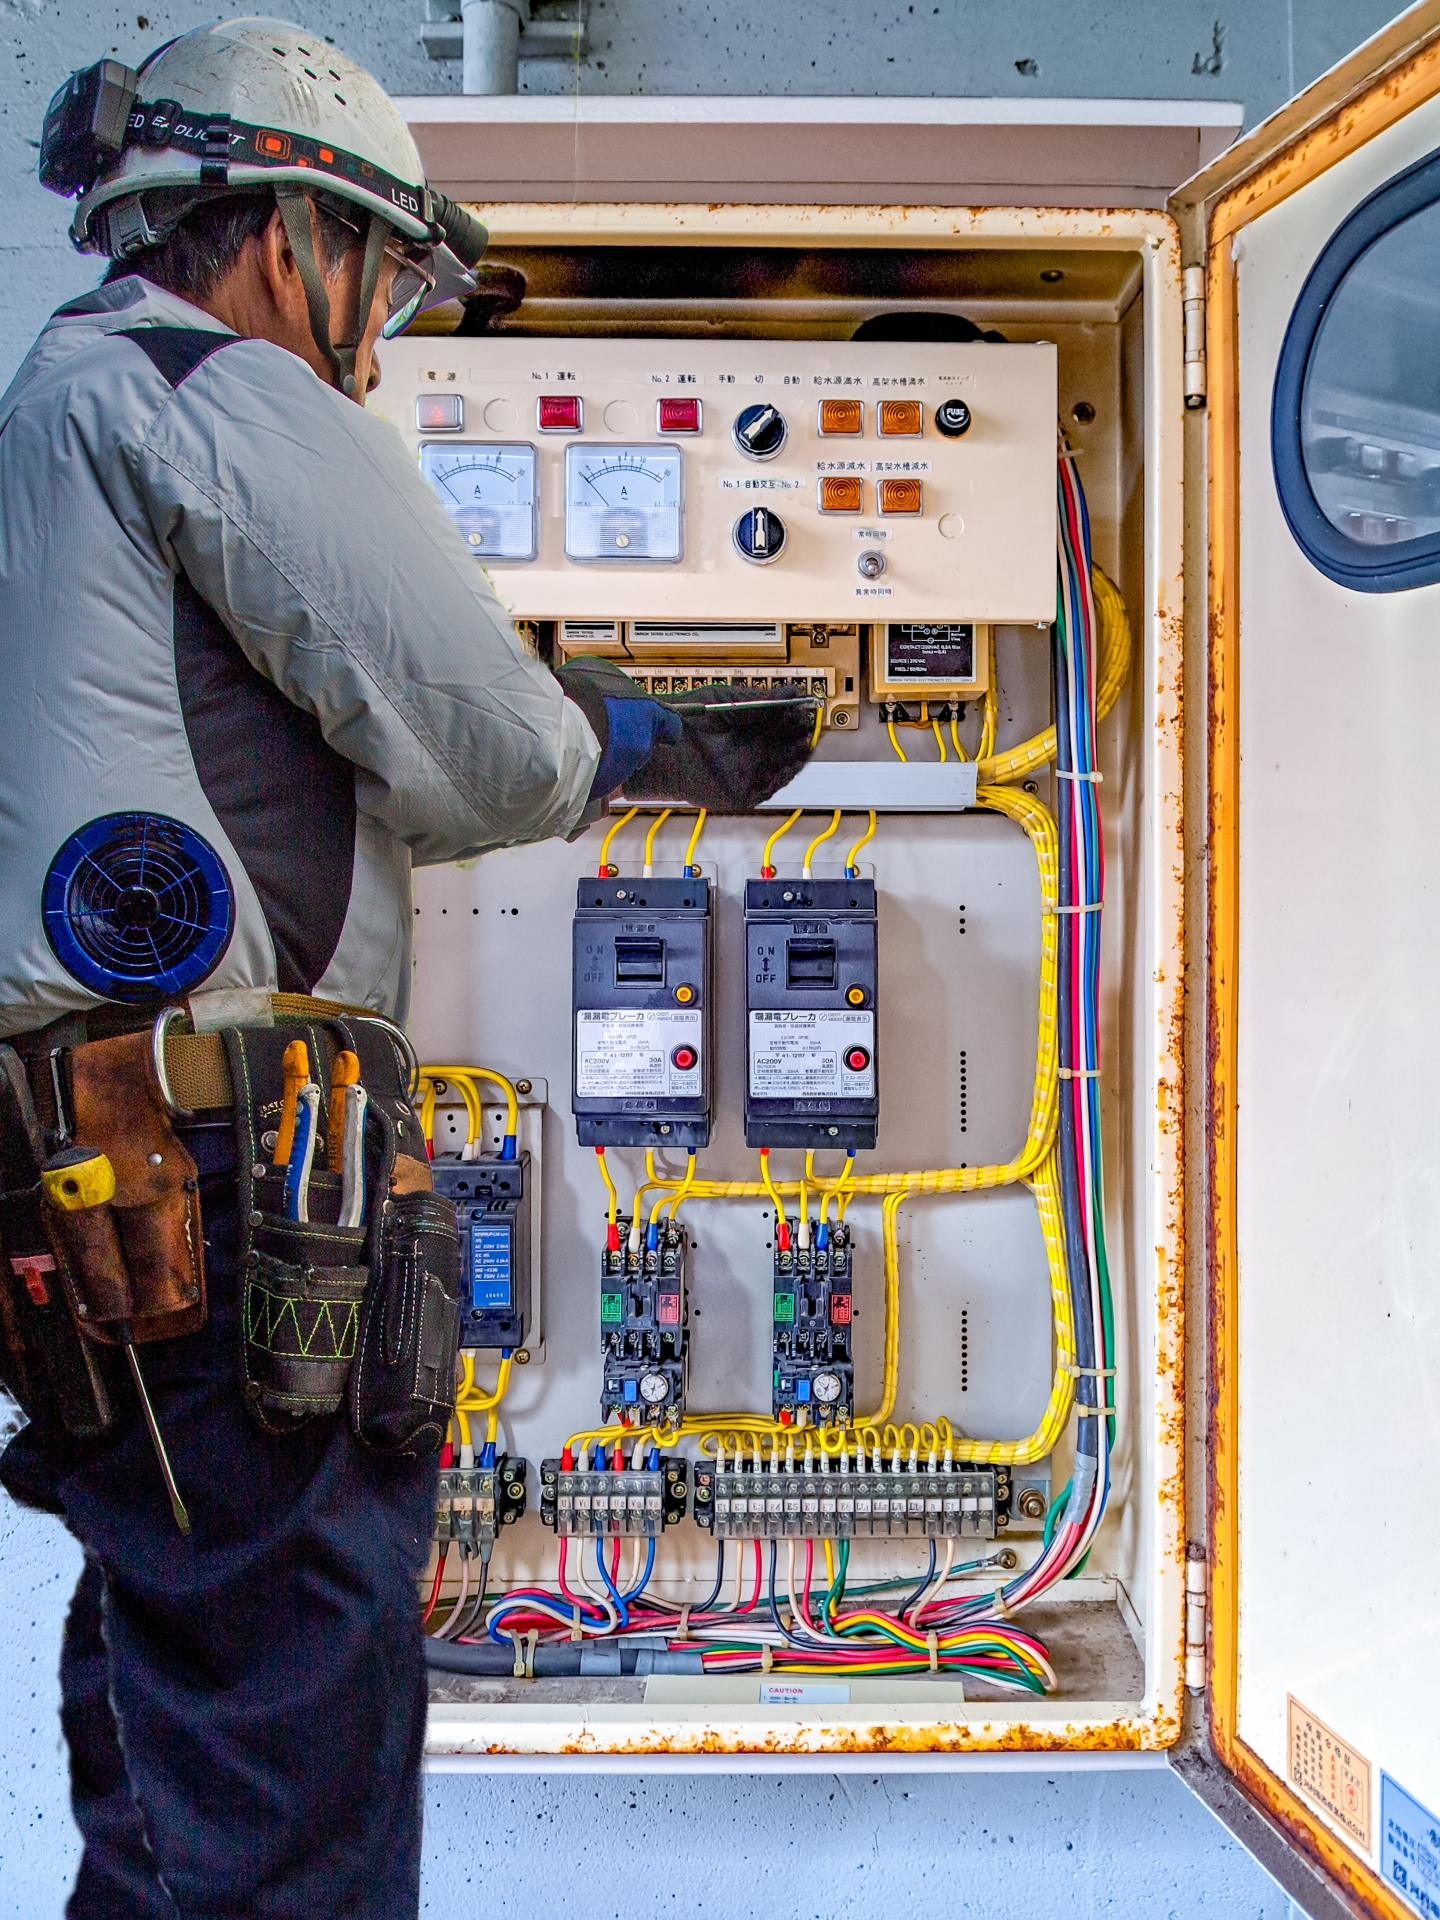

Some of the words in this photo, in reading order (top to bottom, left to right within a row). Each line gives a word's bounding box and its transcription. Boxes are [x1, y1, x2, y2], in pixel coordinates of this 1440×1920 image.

[391, 187, 418, 213] LED
[557, 371, 576, 381] 運転
[677, 374, 697, 383] 運転
[718, 374, 736, 384] 手動
[754, 375, 764, 384] 切
[784, 376, 801, 384] 自動
[813, 376, 863, 386] 給水源満水
[872, 377, 926, 387] 高架水槽満水
[946, 407, 965, 417] FUSE
[817, 462, 866, 471] 給水源減水
[875, 462, 929, 471] 高架水槽減水
[474, 484, 482, 495] A
[621, 486, 628, 496] A
[757, 946, 775, 956] ON
[584, 973, 605, 982] OFF
[755, 974, 776, 983] OFF
[460, 1501, 465, 1509] S
[614, 1500, 625, 1508] U2
[717, 1503, 726, 1511] E1
[734, 1503, 745, 1511] E2
[752, 1503, 763, 1511] E3
[770, 1503, 780, 1511] E4
[787, 1502, 798, 1510] E5
[805, 1502, 816, 1510] E6
[822, 1502, 833, 1510] E7
[841, 1502, 852, 1510] E8
